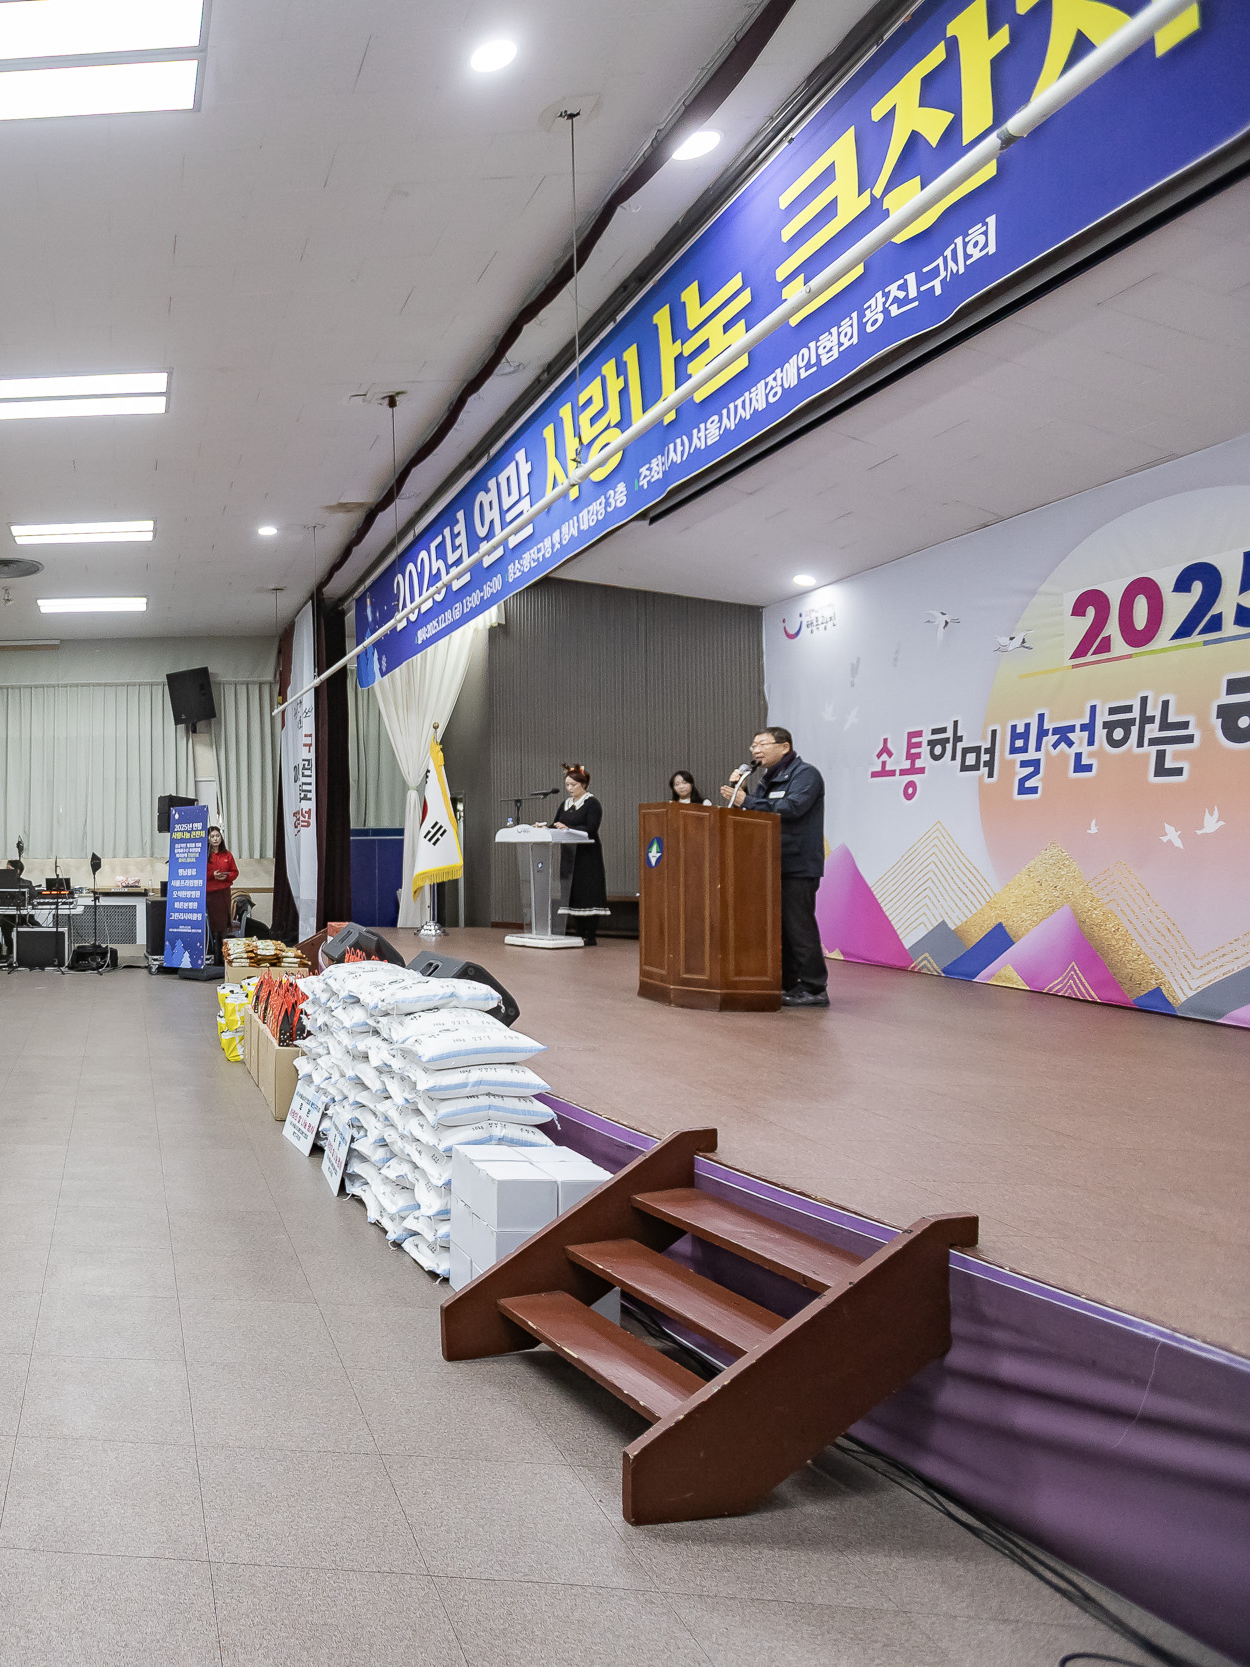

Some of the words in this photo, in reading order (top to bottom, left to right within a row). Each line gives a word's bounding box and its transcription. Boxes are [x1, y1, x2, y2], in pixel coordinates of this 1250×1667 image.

[393, 508, 471, 632] 2025년
[473, 447, 534, 569] 연말
[543, 271, 752, 502] 사랑나눔
[561, 516, 578, 546] 청사
[579, 495, 605, 531] 대강당
[606, 481, 627, 512] 3층
[870, 719, 998, 801] 소통하며
[1008, 695, 1195, 796] 발전하는
